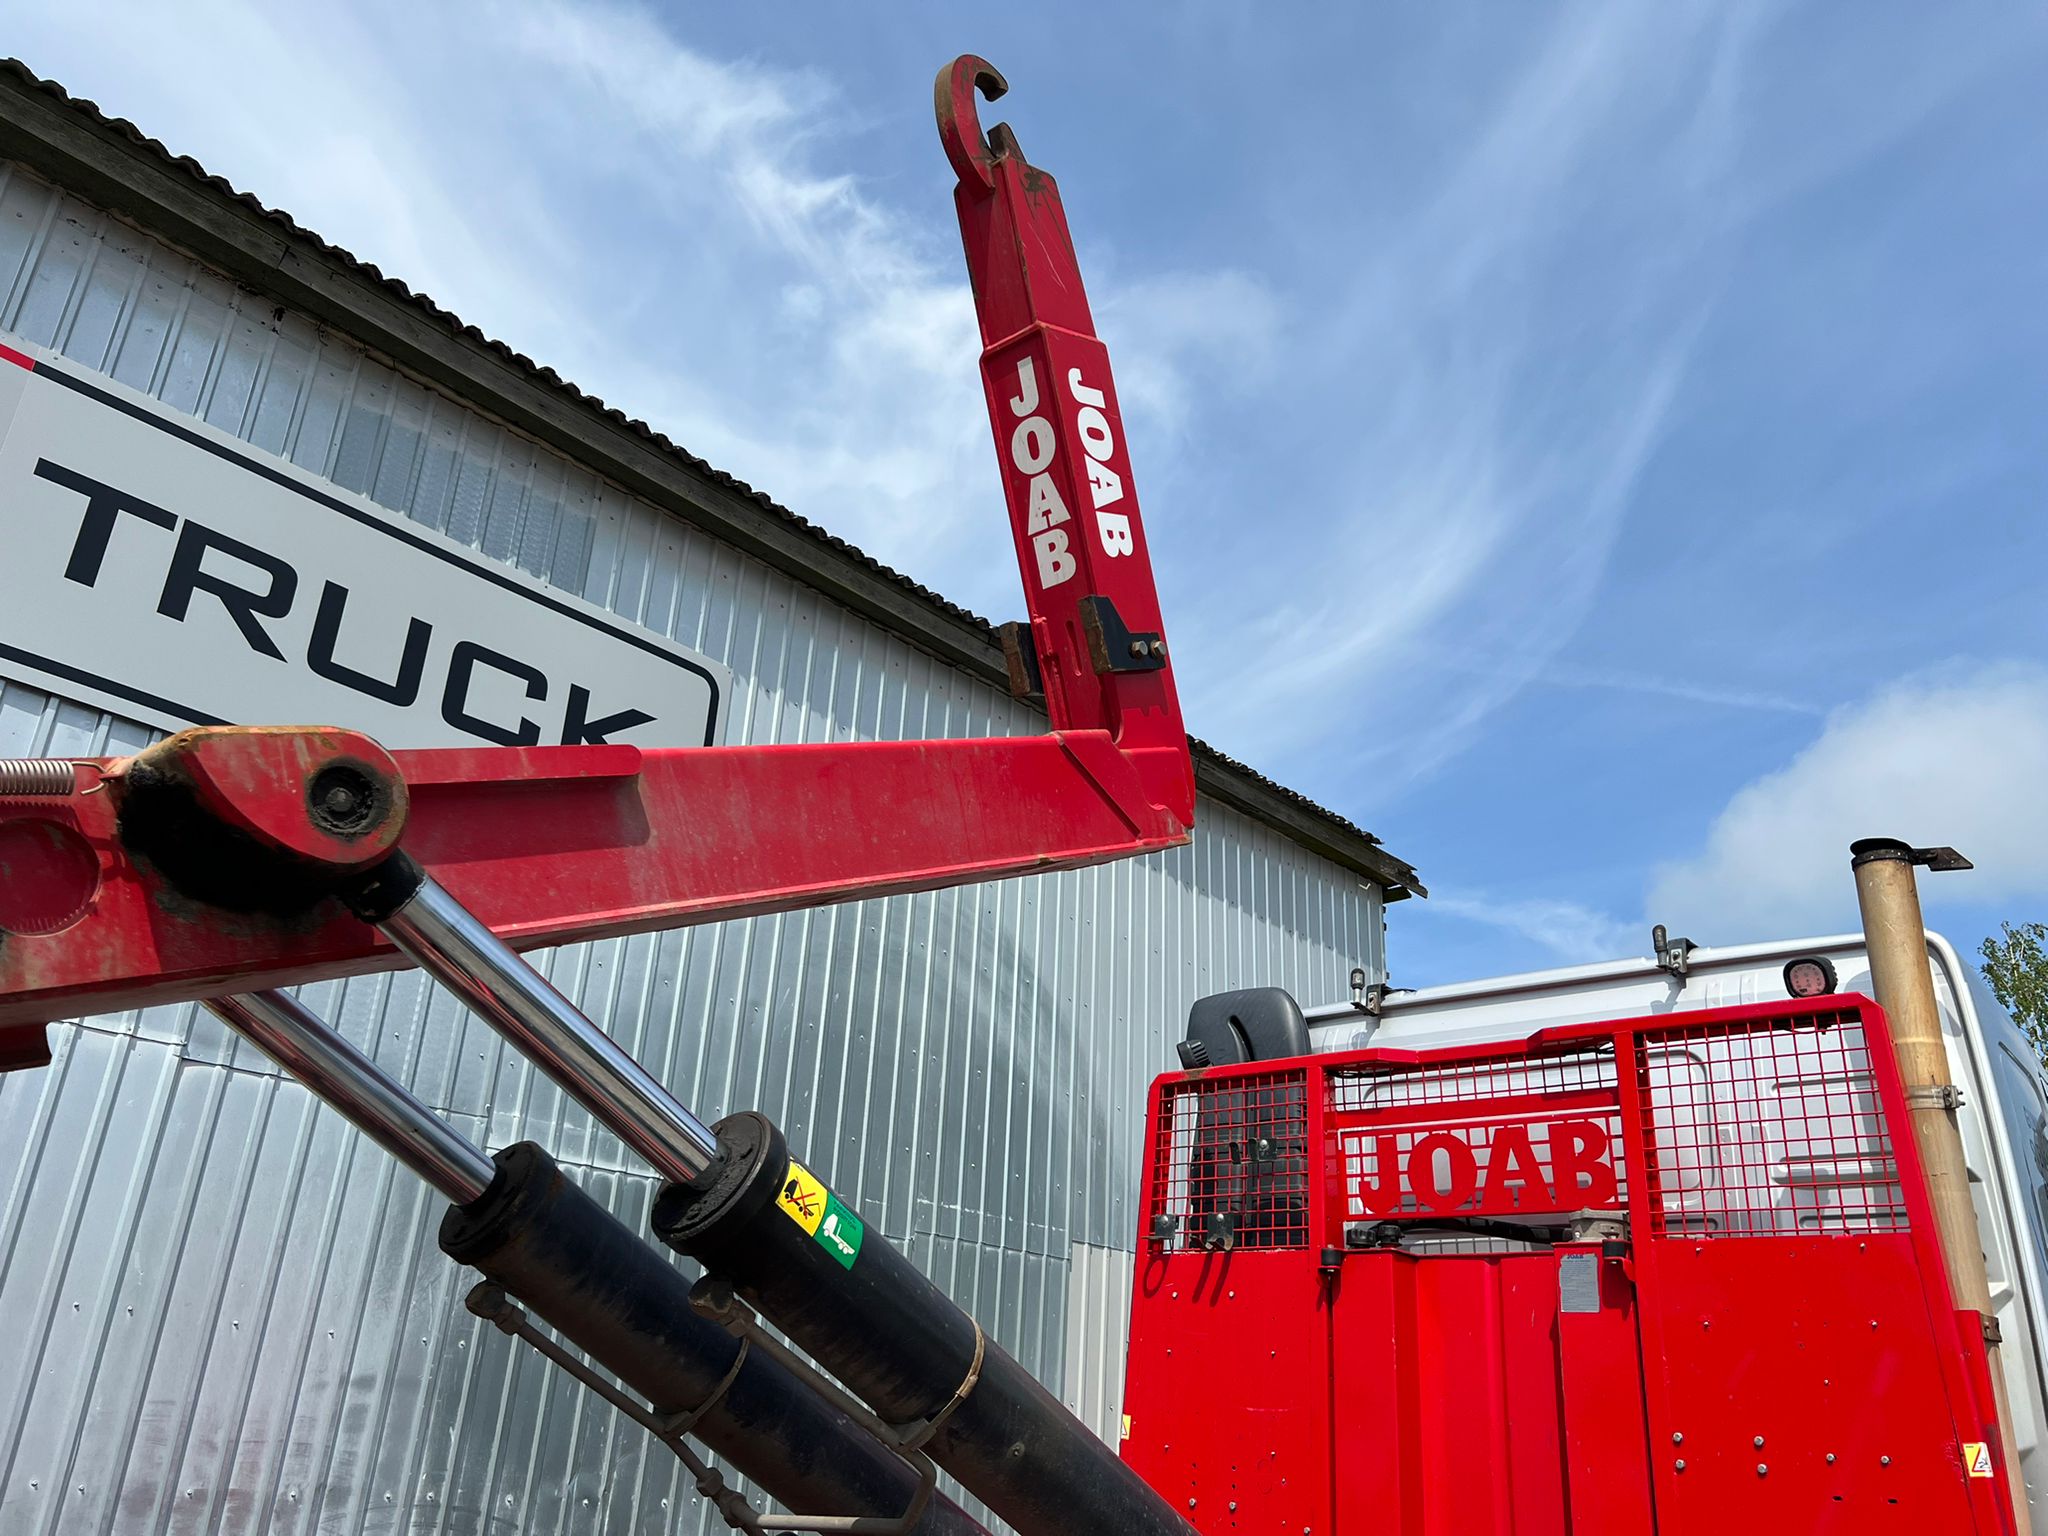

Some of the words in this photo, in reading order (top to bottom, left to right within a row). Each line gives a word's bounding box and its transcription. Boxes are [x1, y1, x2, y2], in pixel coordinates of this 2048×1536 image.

[1010, 356, 1076, 590] JOAB
[1068, 367, 1134, 558] JOAB
[34, 457, 658, 746] TRUCK
[1359, 1119, 1616, 1214] JOAB
